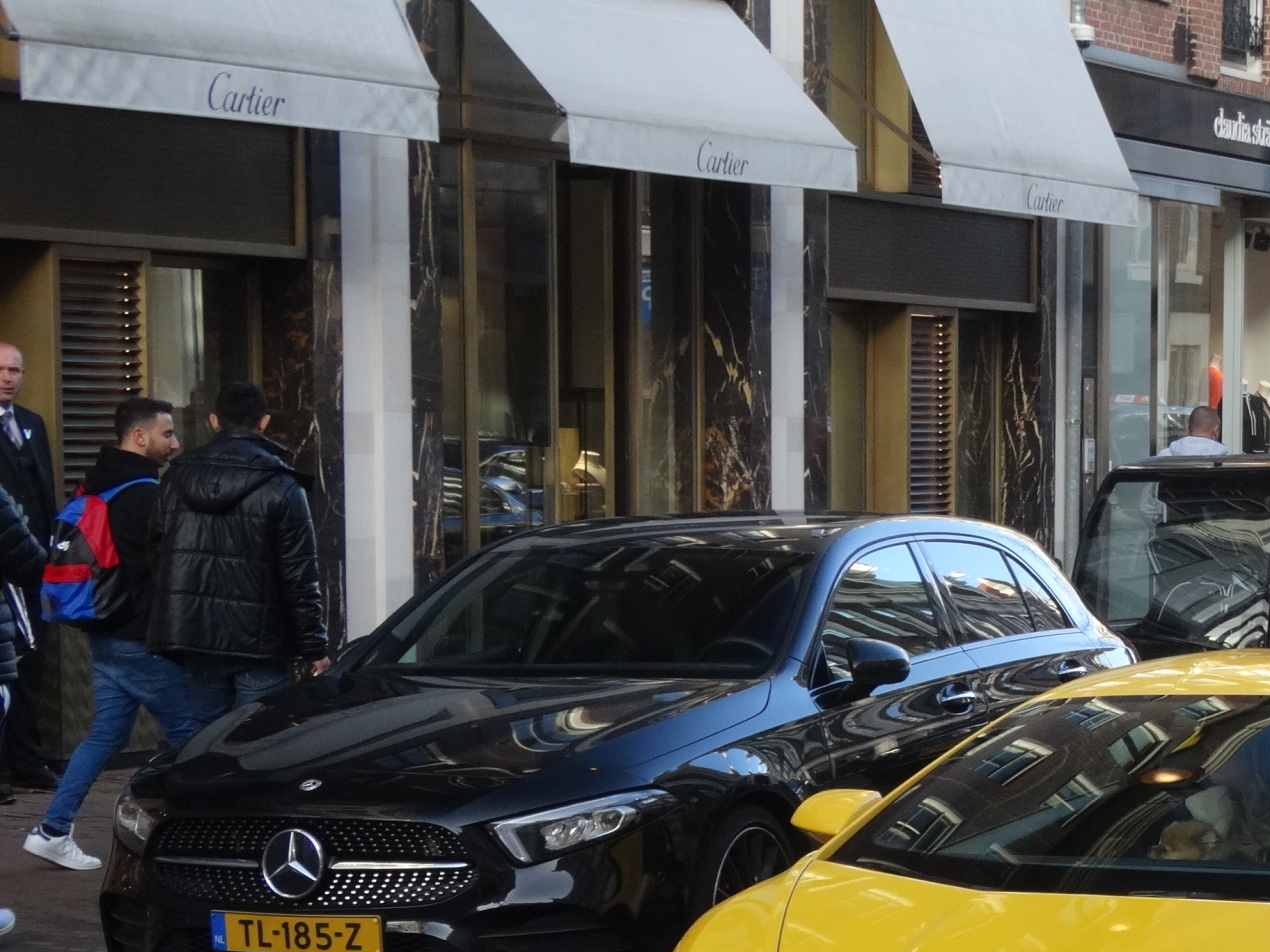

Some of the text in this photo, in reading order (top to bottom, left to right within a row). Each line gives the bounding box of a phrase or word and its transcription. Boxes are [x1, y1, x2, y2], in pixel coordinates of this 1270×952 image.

[208, 72, 286, 116] Cartier
[1214, 107, 1251, 143] claudia
[697, 140, 749, 176] Cartier
[1027, 183, 1064, 213] Cartier
[214, 935, 226, 944] NL
[238, 919, 363, 951] TL-185-Z
